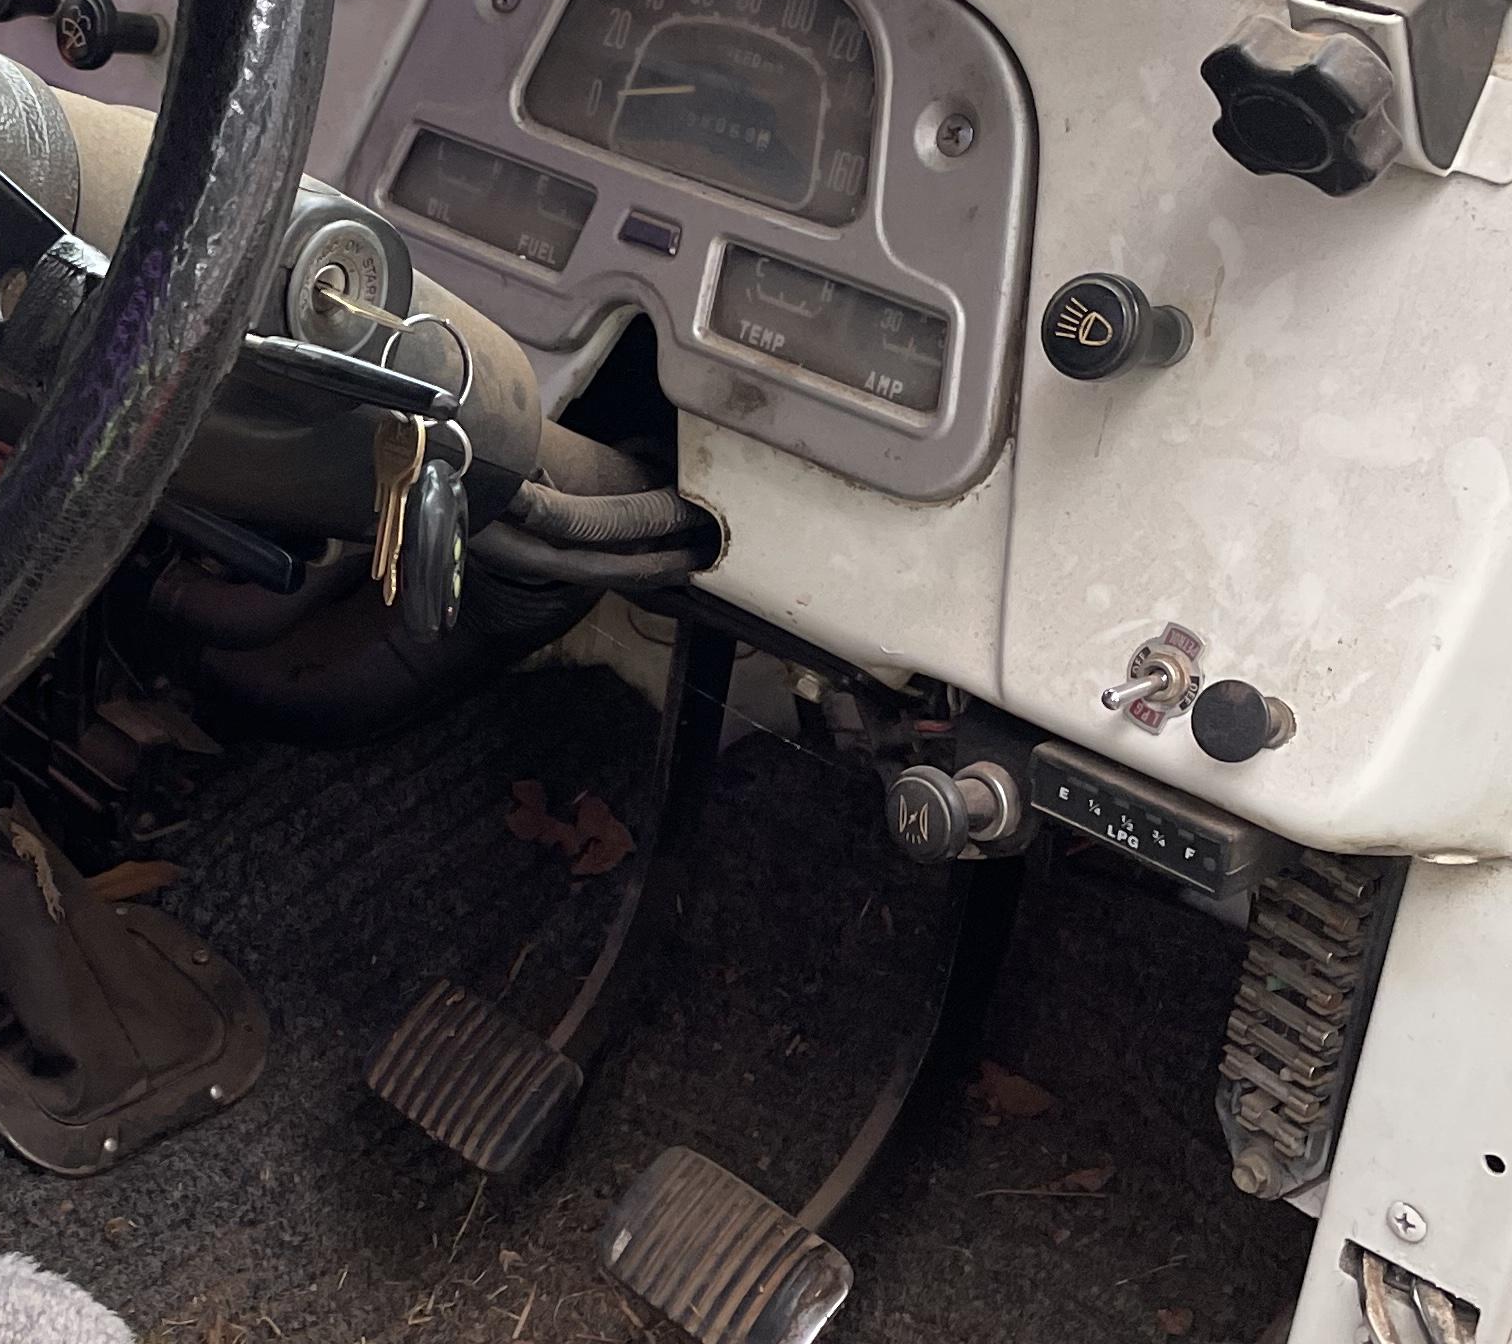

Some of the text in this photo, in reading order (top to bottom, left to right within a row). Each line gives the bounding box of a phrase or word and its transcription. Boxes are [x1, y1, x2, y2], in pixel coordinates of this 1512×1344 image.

[602, 7, 632, 50] 20
[829, 17, 864, 63] 120
[825, 148, 865, 196] 160
[516, 234, 557, 266] FUEL
[755, 257, 836, 303] C H
[738, 318, 785, 351] TEMP
[863, 370, 904, 399] AMP
[1058, 786, 1070, 801] E
[1185, 847, 1196, 859] F
[1106, 824, 1139, 849] LPG
